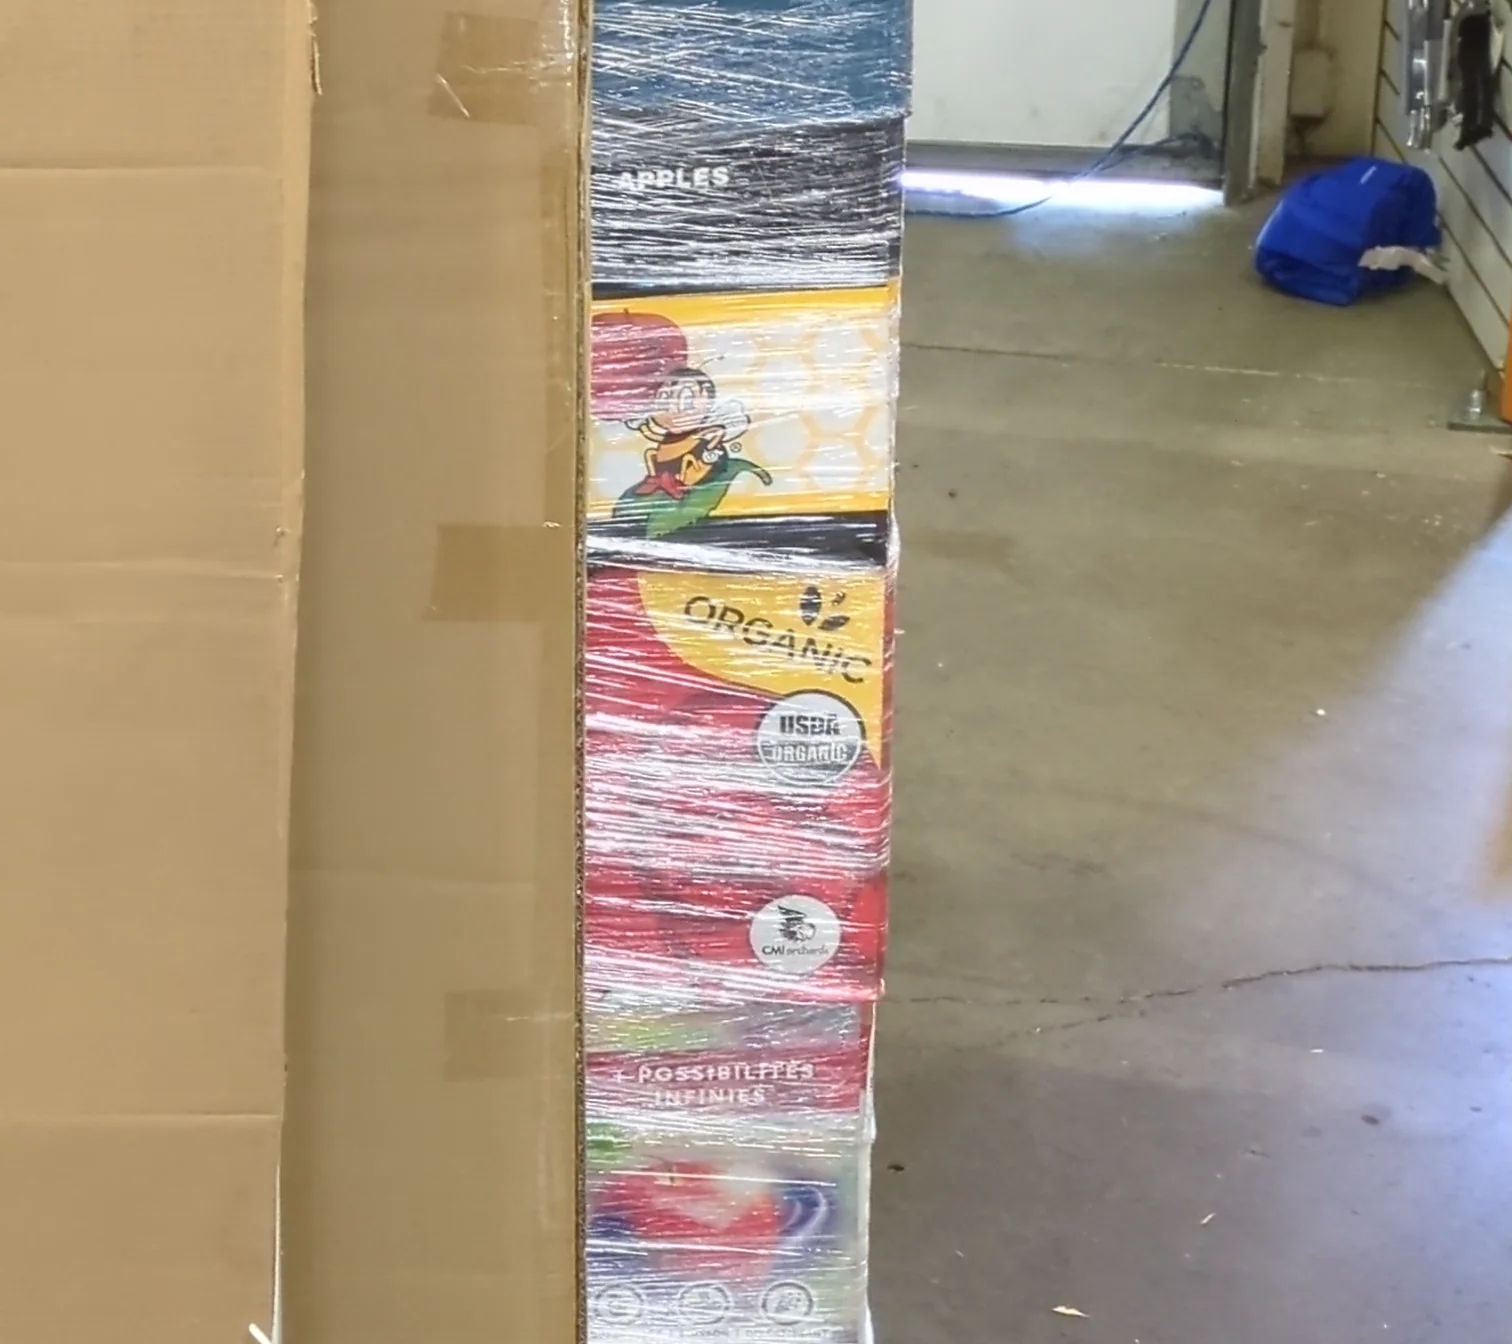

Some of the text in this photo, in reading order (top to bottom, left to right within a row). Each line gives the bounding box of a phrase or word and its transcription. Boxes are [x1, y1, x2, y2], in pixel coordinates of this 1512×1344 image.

[618, 166, 731, 193] APPLES
[683, 595, 873, 685] ORGANIC
[778, 713, 841, 736] USDA
[770, 742, 849, 764] ORGANIC
